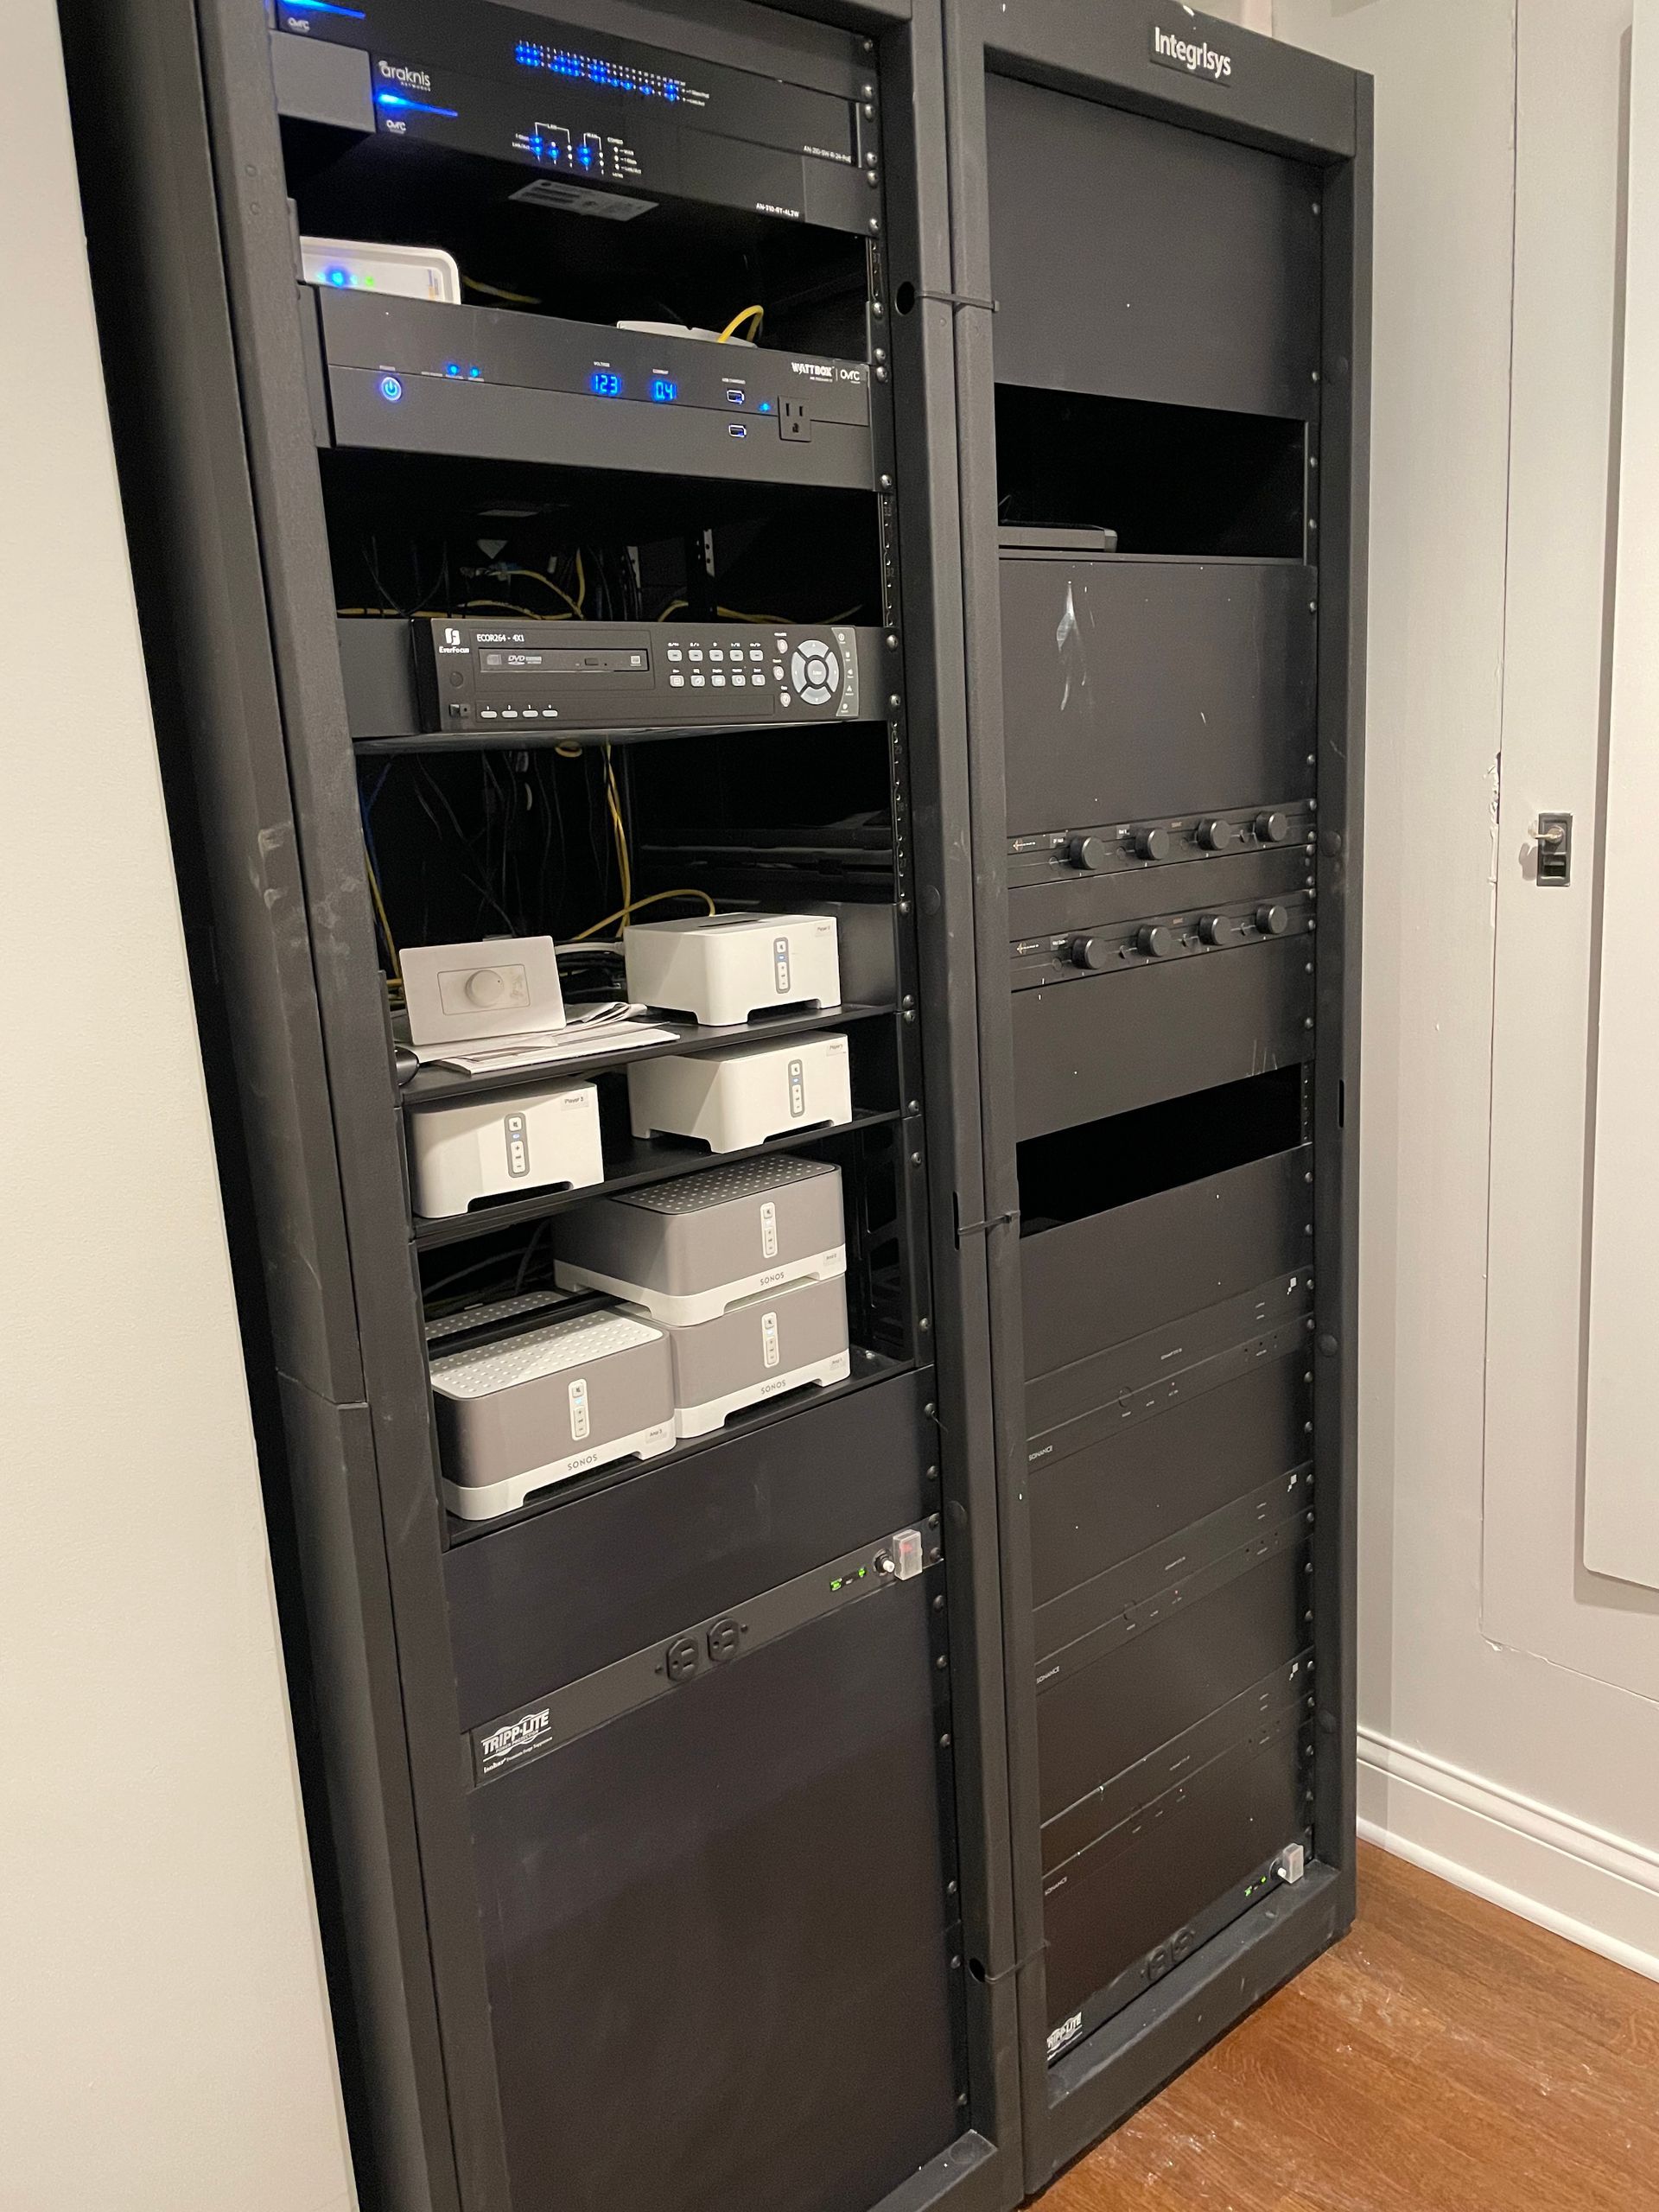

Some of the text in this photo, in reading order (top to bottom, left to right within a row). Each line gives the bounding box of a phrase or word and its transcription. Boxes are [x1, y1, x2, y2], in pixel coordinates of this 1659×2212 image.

[594, 375, 618, 393] 123
[476, 633, 506, 642] ECOR264
[760, 1271, 785, 1286] SONOS
[760, 1379, 786, 1395] SONOS
[567, 1453, 598, 1471] SONOS
